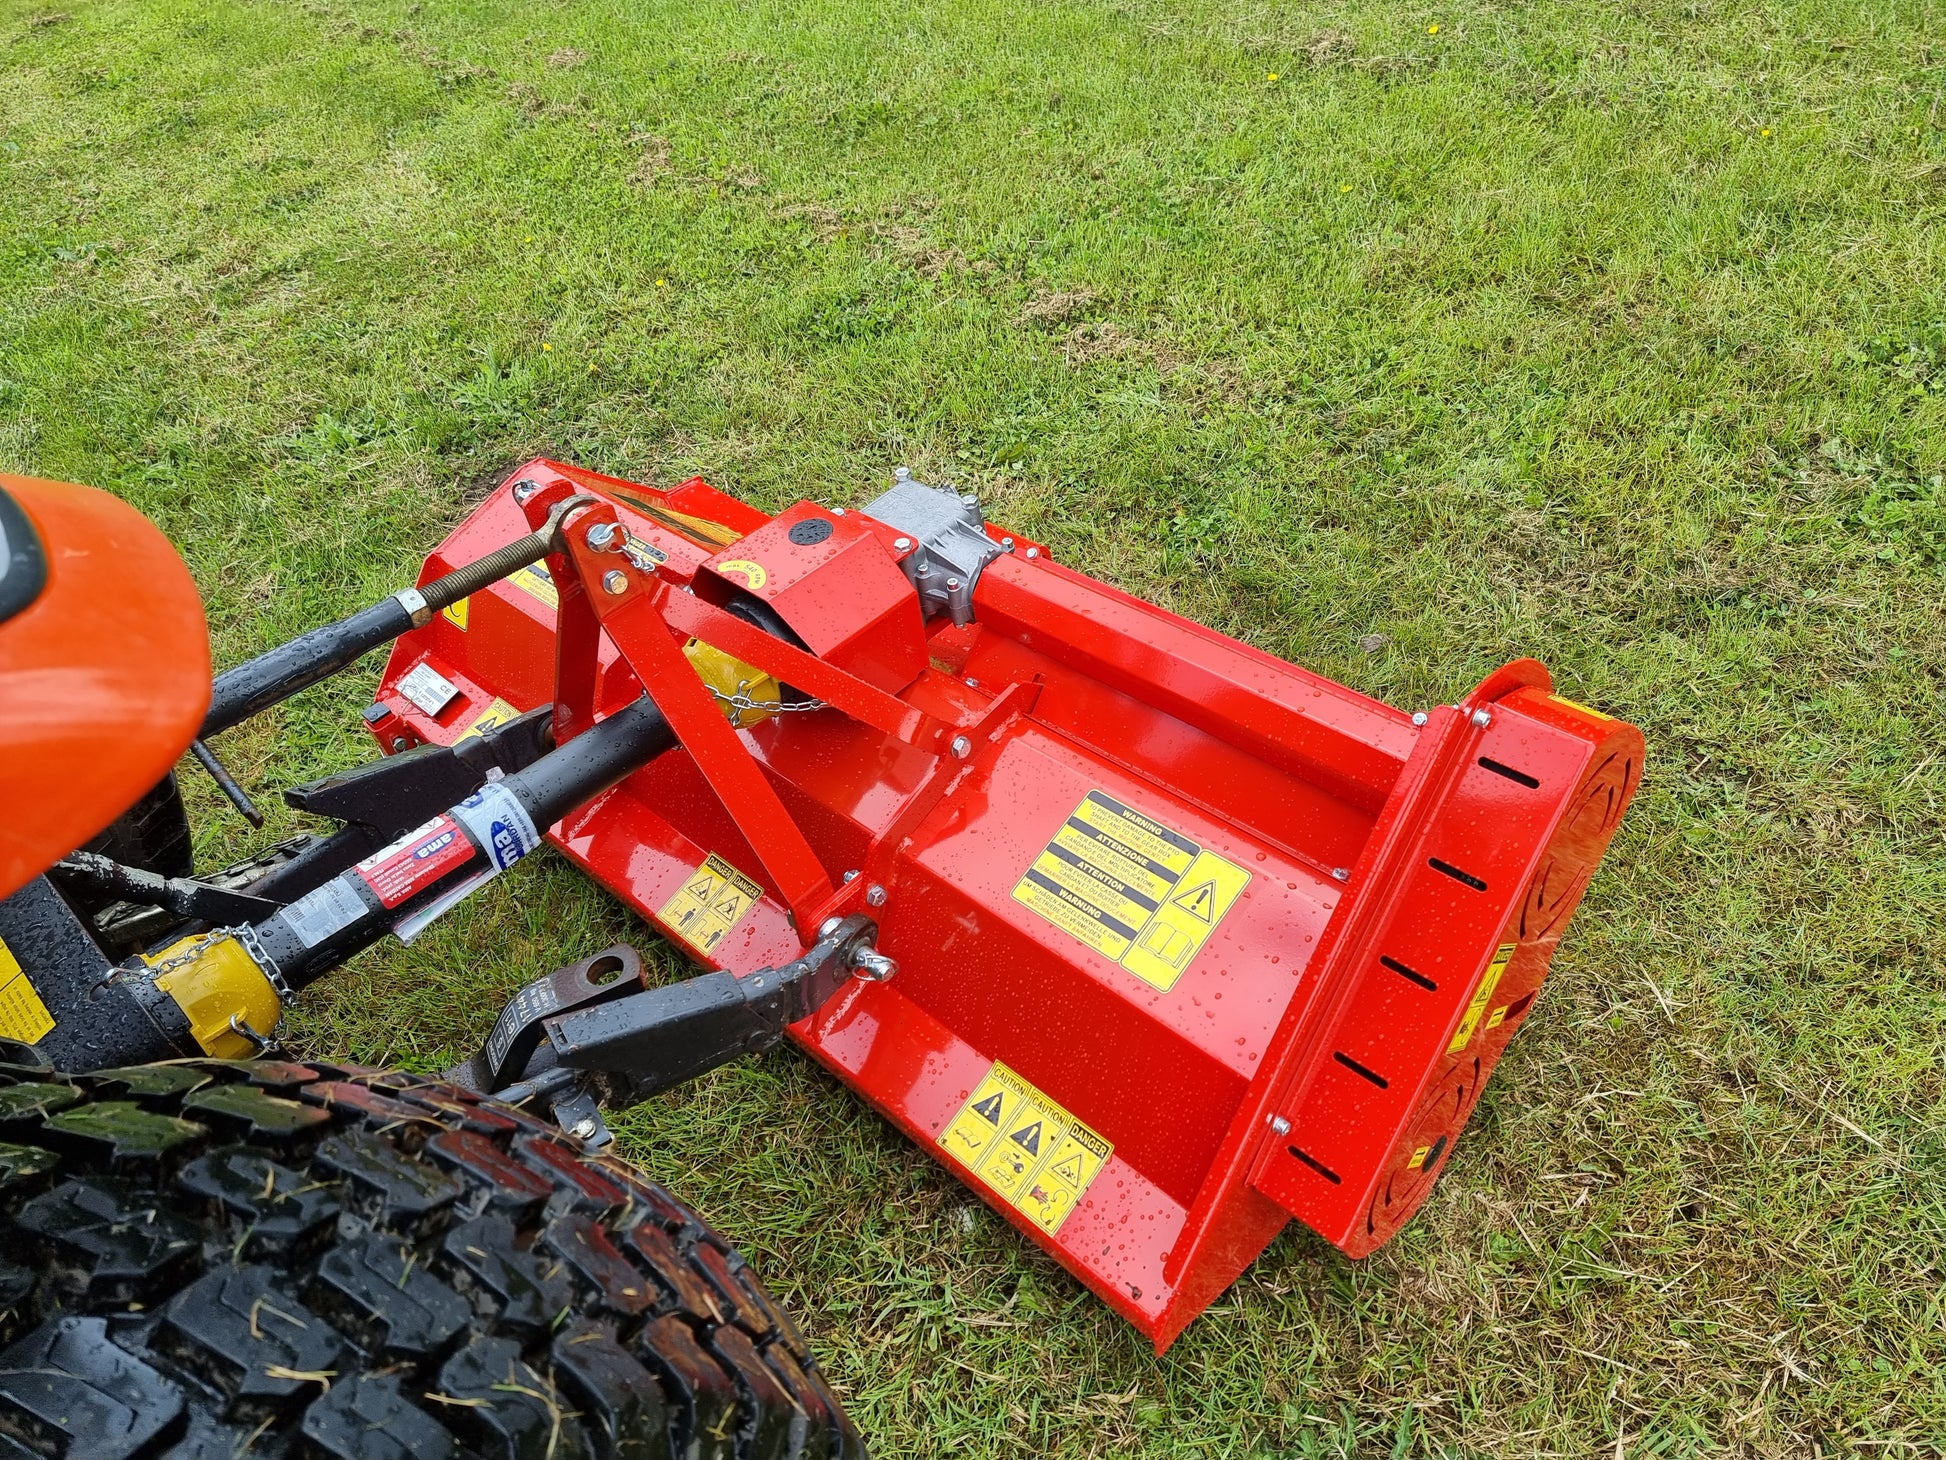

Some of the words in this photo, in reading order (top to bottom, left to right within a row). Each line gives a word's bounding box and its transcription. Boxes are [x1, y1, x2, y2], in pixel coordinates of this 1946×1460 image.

[440, 684, 452, 695] CE
[1091, 811, 1108, 823] SHAFT
[1109, 821, 1121, 830] AND
[1130, 832, 1140, 840] THE
[1142, 839, 1158, 850] GEAR
[1158, 848, 1171, 857] BOX
[1097, 807, 1122, 823] PREVENT
[1122, 821, 1146, 836] DAMAGE
[1155, 840, 1167, 848] THE
[1167, 846, 1180, 855] PTO
[1122, 810, 1162, 834] WARNING
[416, 832, 452, 858] ama
[1089, 817, 1106, 828] START
[1118, 833, 1142, 848] MACHINE
[1143, 847, 1166, 862] GENTLY
[1095, 833, 1149, 866] ATTENZIONE
[707, 857, 732, 878] DANGER
[1065, 835, 1092, 852] CARDANO
[1097, 853, 1108, 861] DEL
[1108, 859, 1155, 888] MOLTIPLICATORE
[1077, 834, 1088, 843] PER
[1088, 841, 1110, 855] EVITARE
[1111, 854, 1137, 871] ROTTURE
[1138, 869, 1150, 878] DEL
[734, 877, 759, 898] DANGER
[1058, 861, 1072, 872] POUR
[1073, 870, 1092, 883] EVITER
[1100, 886, 1118, 899] CASSE
[1059, 869, 1081, 884] CARDAN
[1077, 860, 1125, 891] ATTENTION
[1034, 895, 1061, 913] GETRIEBE
[1070, 916, 1101, 938] VERMEIDEN
[1058, 888, 1102, 918] WARNUNG
[1066, 907, 1107, 934] GELENKWELLE
[1108, 932, 1120, 942] UND
[516, 995, 530, 1022] 1744
[993, 1067, 1026, 1096] CAUTION
[1031, 1095, 1065, 1125] CAUTION
[1070, 1124, 1107, 1156] DANGER
